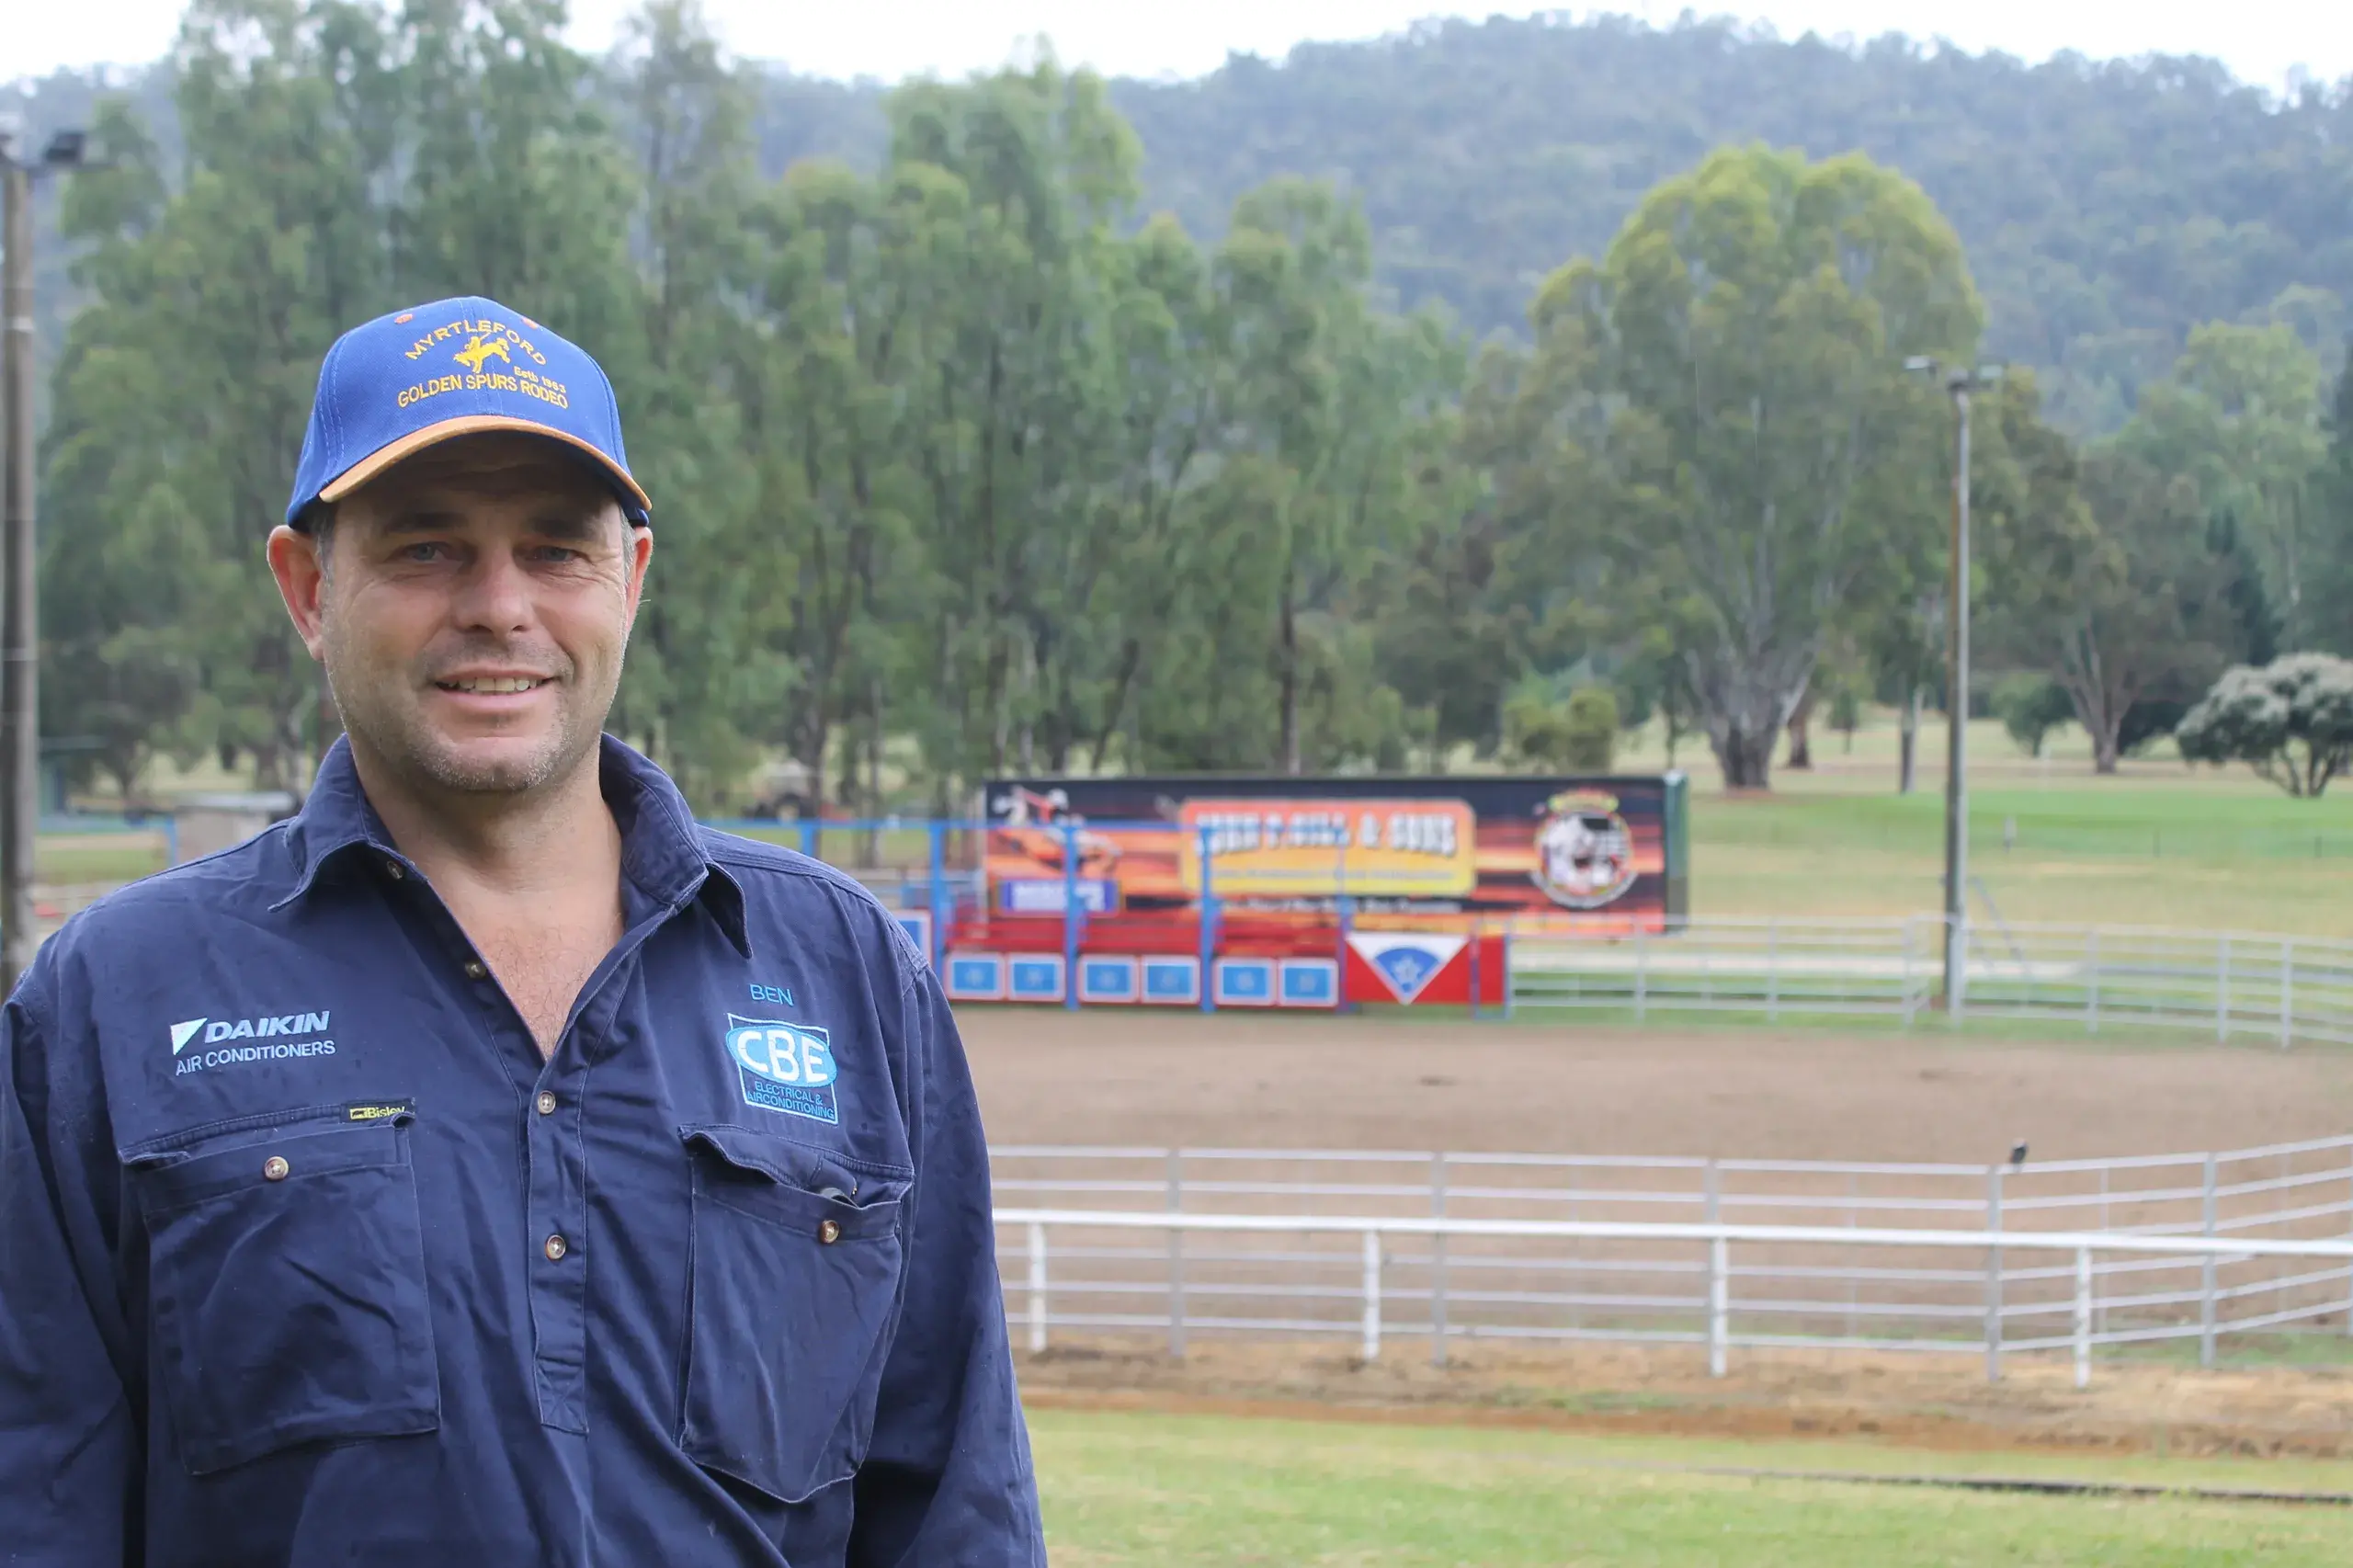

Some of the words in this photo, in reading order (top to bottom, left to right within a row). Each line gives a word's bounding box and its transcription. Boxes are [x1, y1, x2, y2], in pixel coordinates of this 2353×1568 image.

[405, 320, 547, 366] MYRTLEFORD
[397, 374, 462, 408] GOLDEN
[466, 372, 517, 392] SPURS
[520, 379, 569, 410] RODEO
[750, 983, 794, 1006] BEN
[204, 1010, 331, 1044] DAIKIN
[176, 1056, 203, 1076] AIR
[205, 1040, 336, 1069] CONDITIONERS
[737, 1028, 829, 1084] CBE
[746, 1091, 835, 1119] AIRCONDITIONING
[755, 1080, 815, 1103] ELECTRICAL
[815, 1094, 824, 1106] &
